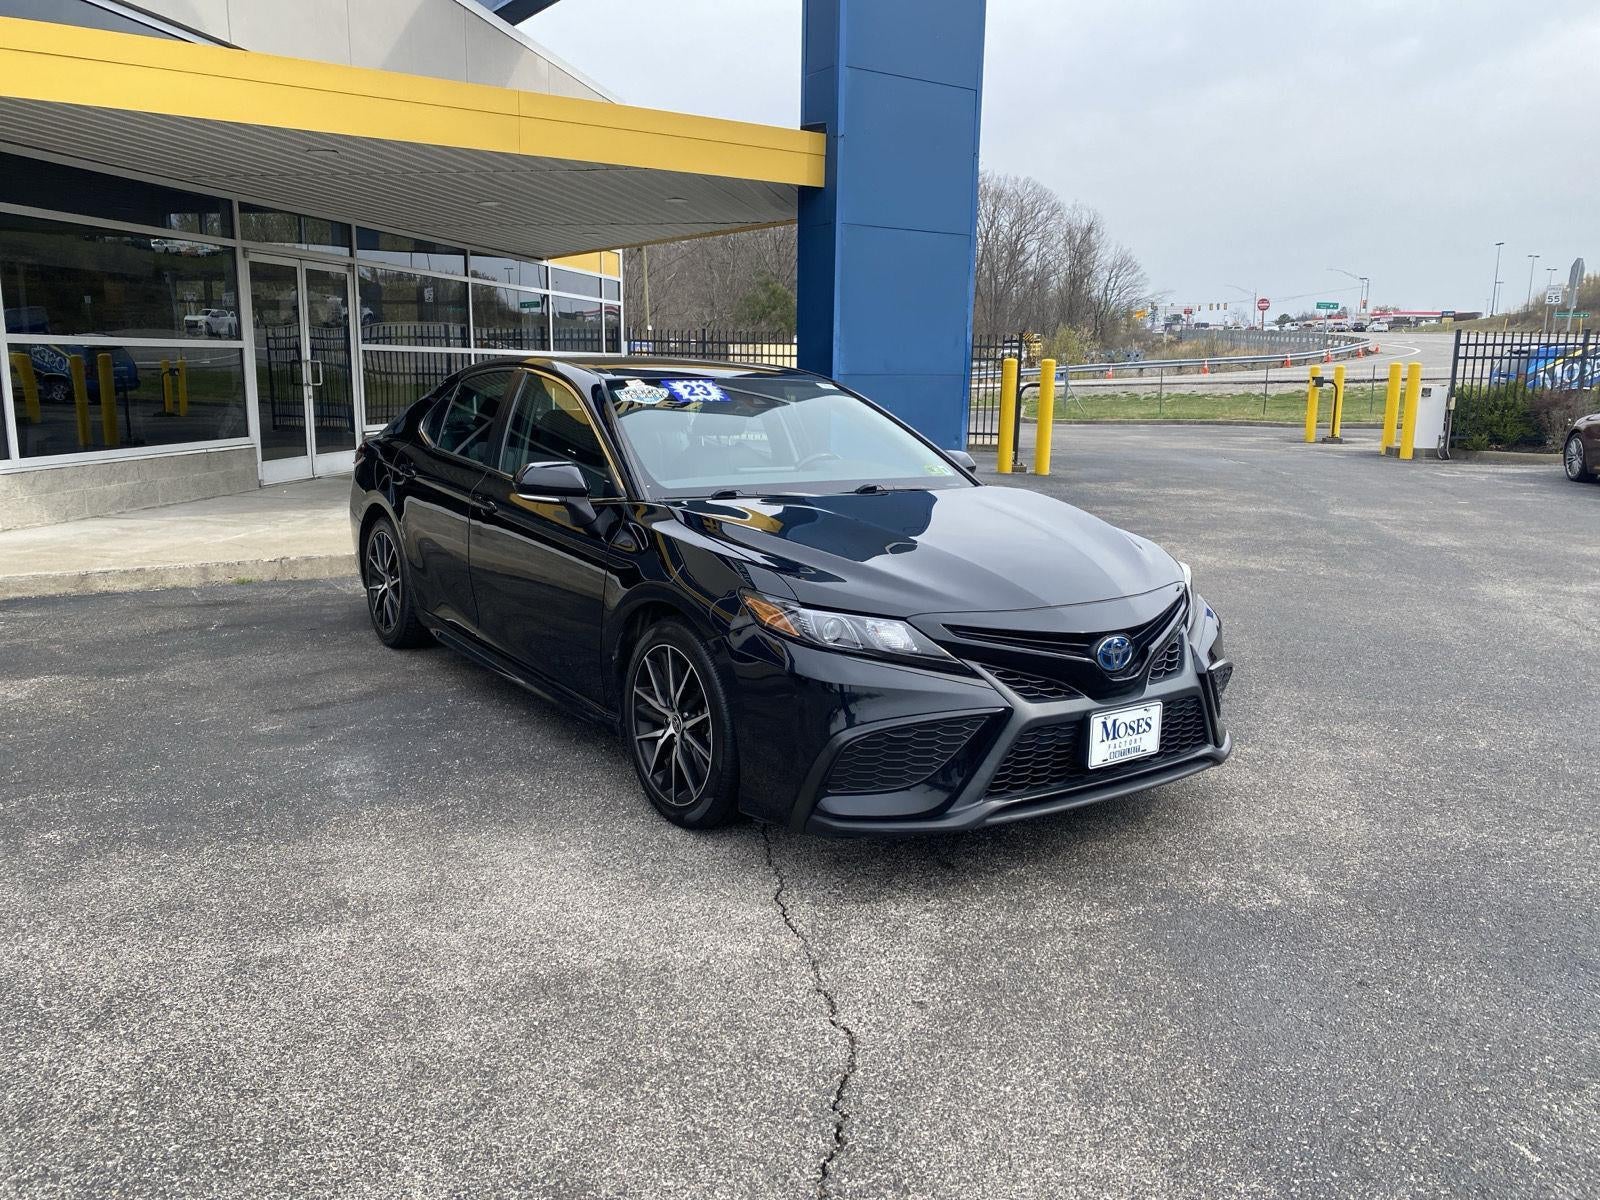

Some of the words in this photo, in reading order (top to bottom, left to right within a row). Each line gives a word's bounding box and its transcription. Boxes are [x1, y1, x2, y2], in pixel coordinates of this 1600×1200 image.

[1547, 295, 1560, 303] 55
[683, 384, 711, 396] 23
[1108, 737, 1142, 750] FACTORY
